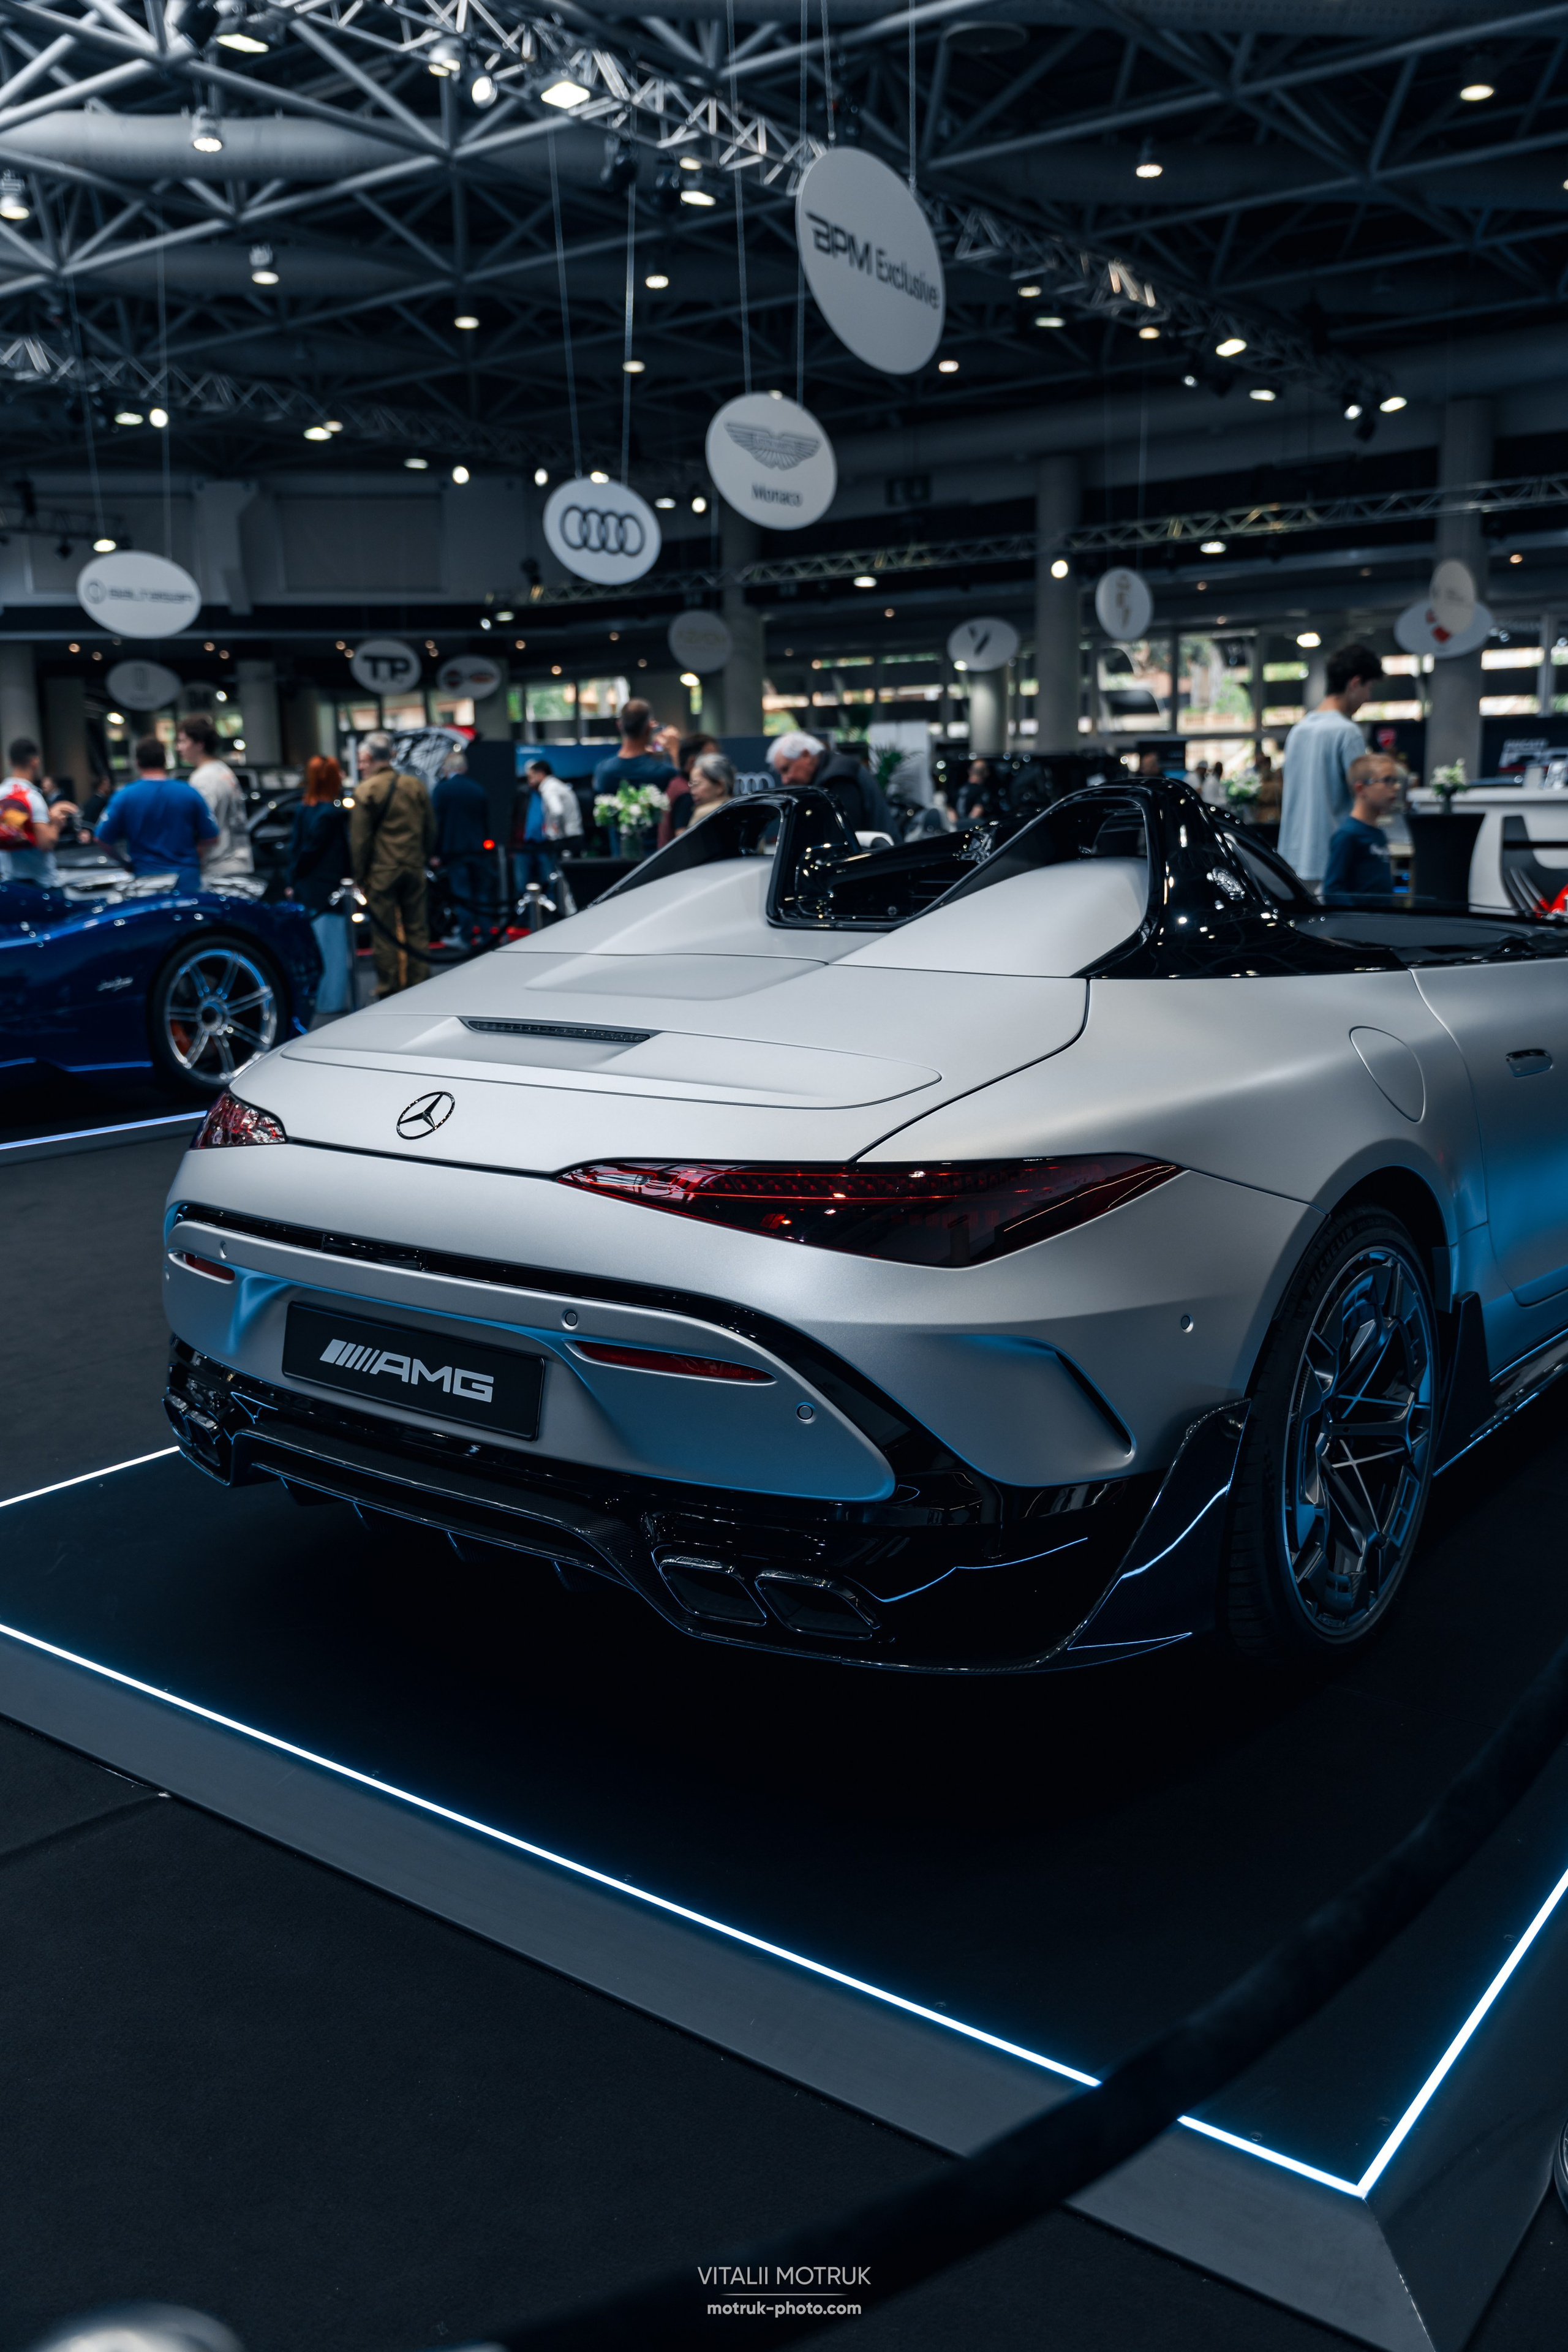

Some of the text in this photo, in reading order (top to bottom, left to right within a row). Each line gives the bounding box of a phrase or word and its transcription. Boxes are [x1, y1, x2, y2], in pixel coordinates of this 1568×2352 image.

[805, 211, 939, 309] BPM Exclusive
[751, 482, 804, 508] Monaco
[1306, 1226, 1354, 1296] MICHELIN
[369, 1351, 494, 1403] AMG
